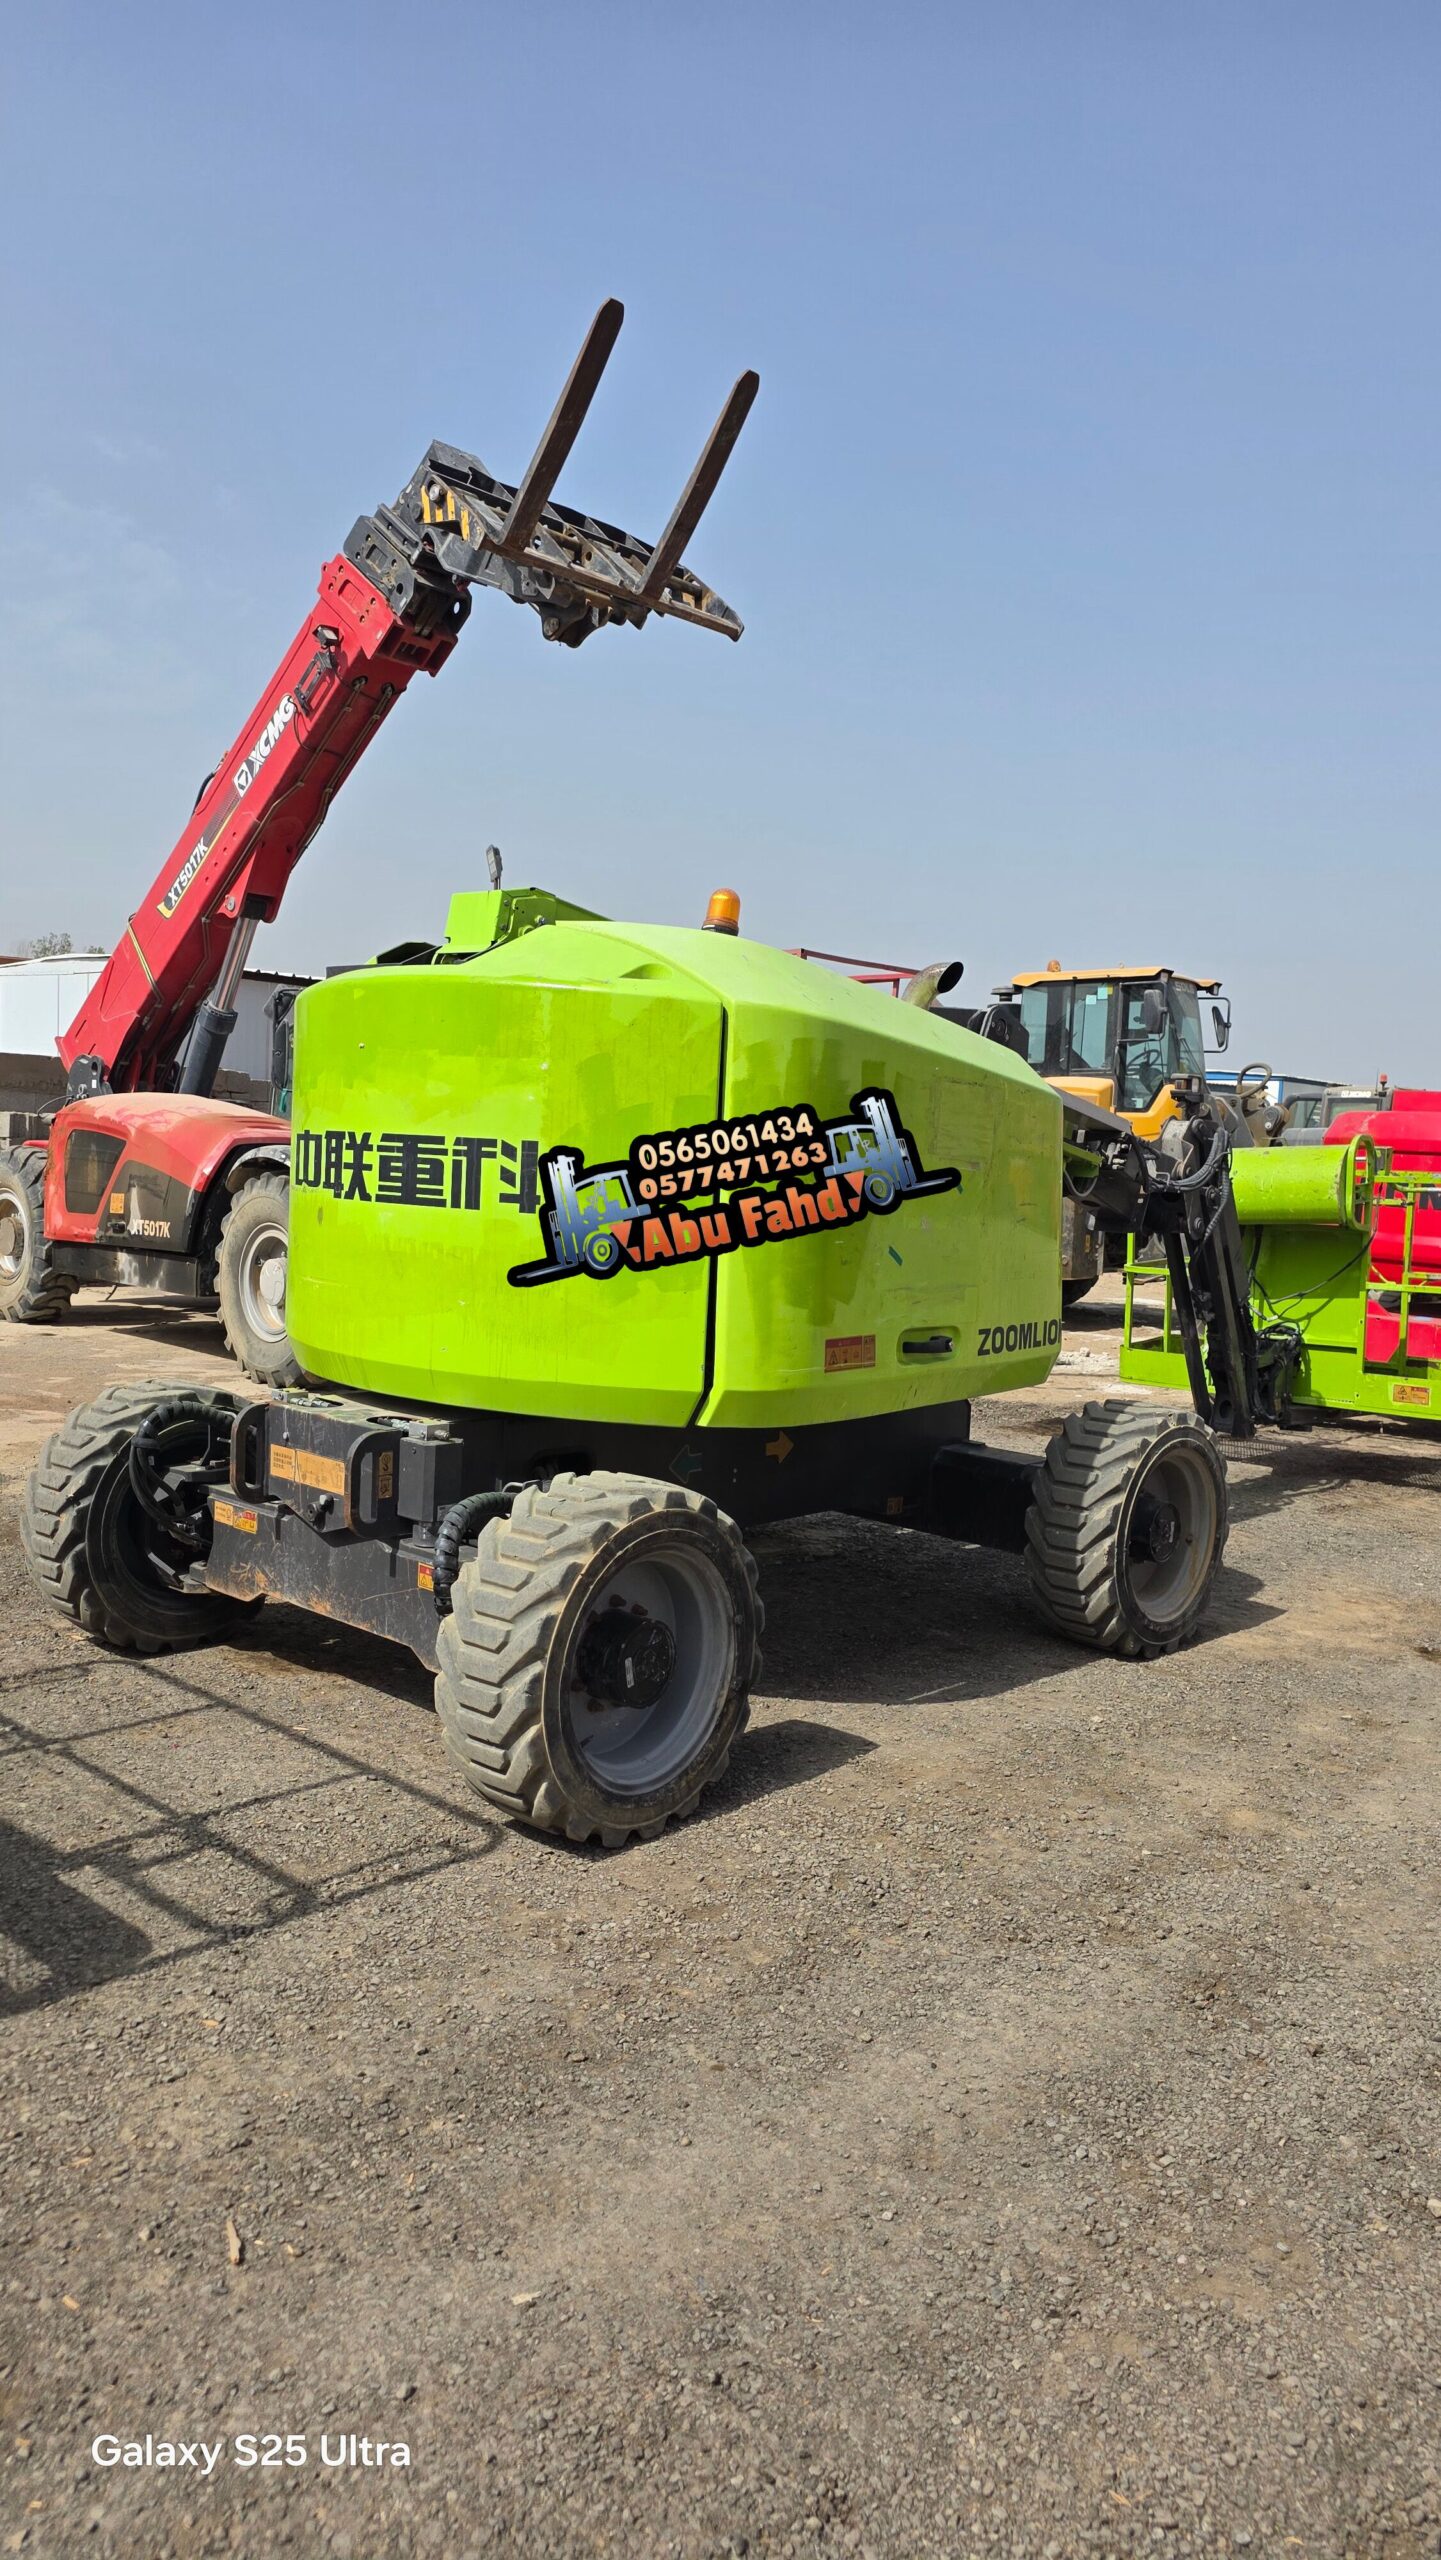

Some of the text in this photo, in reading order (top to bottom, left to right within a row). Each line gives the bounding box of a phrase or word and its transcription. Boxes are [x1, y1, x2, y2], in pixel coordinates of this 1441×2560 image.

[248, 694, 296, 779] XCMG
[168, 836, 209, 907] XT5017K
[295, 1129, 541, 1214] 中联重科
[131, 1219, 171, 1238] XT5017K
